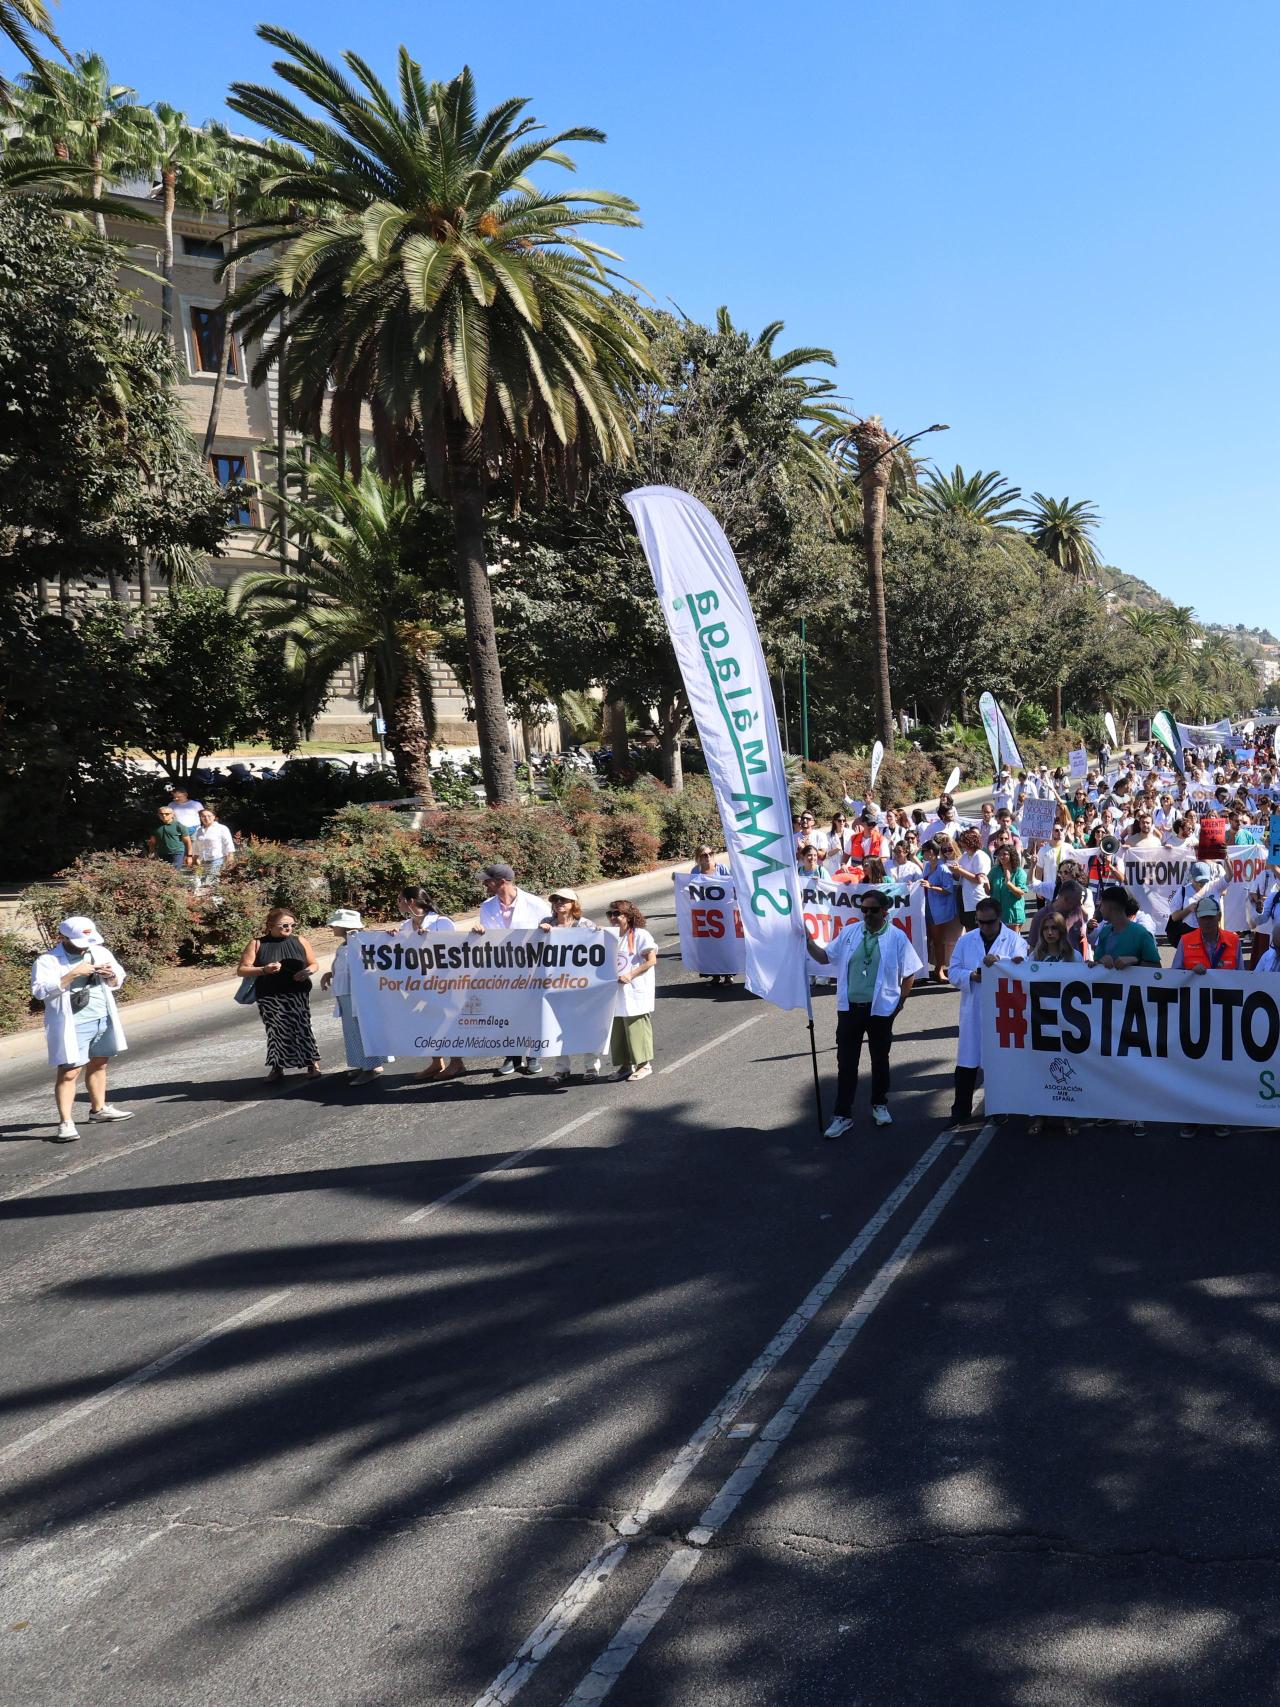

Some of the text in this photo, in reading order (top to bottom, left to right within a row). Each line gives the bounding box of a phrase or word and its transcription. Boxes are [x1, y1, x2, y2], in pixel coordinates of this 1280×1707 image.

[688, 885, 726, 901] NO
[691, 908, 726, 939] ES
[361, 940, 606, 976] #StopEstatutoMarco
[379, 973, 589, 995] Por la dignificación del médico
[414, 1035, 550, 1052] Colegio de Médicos de Málaga
